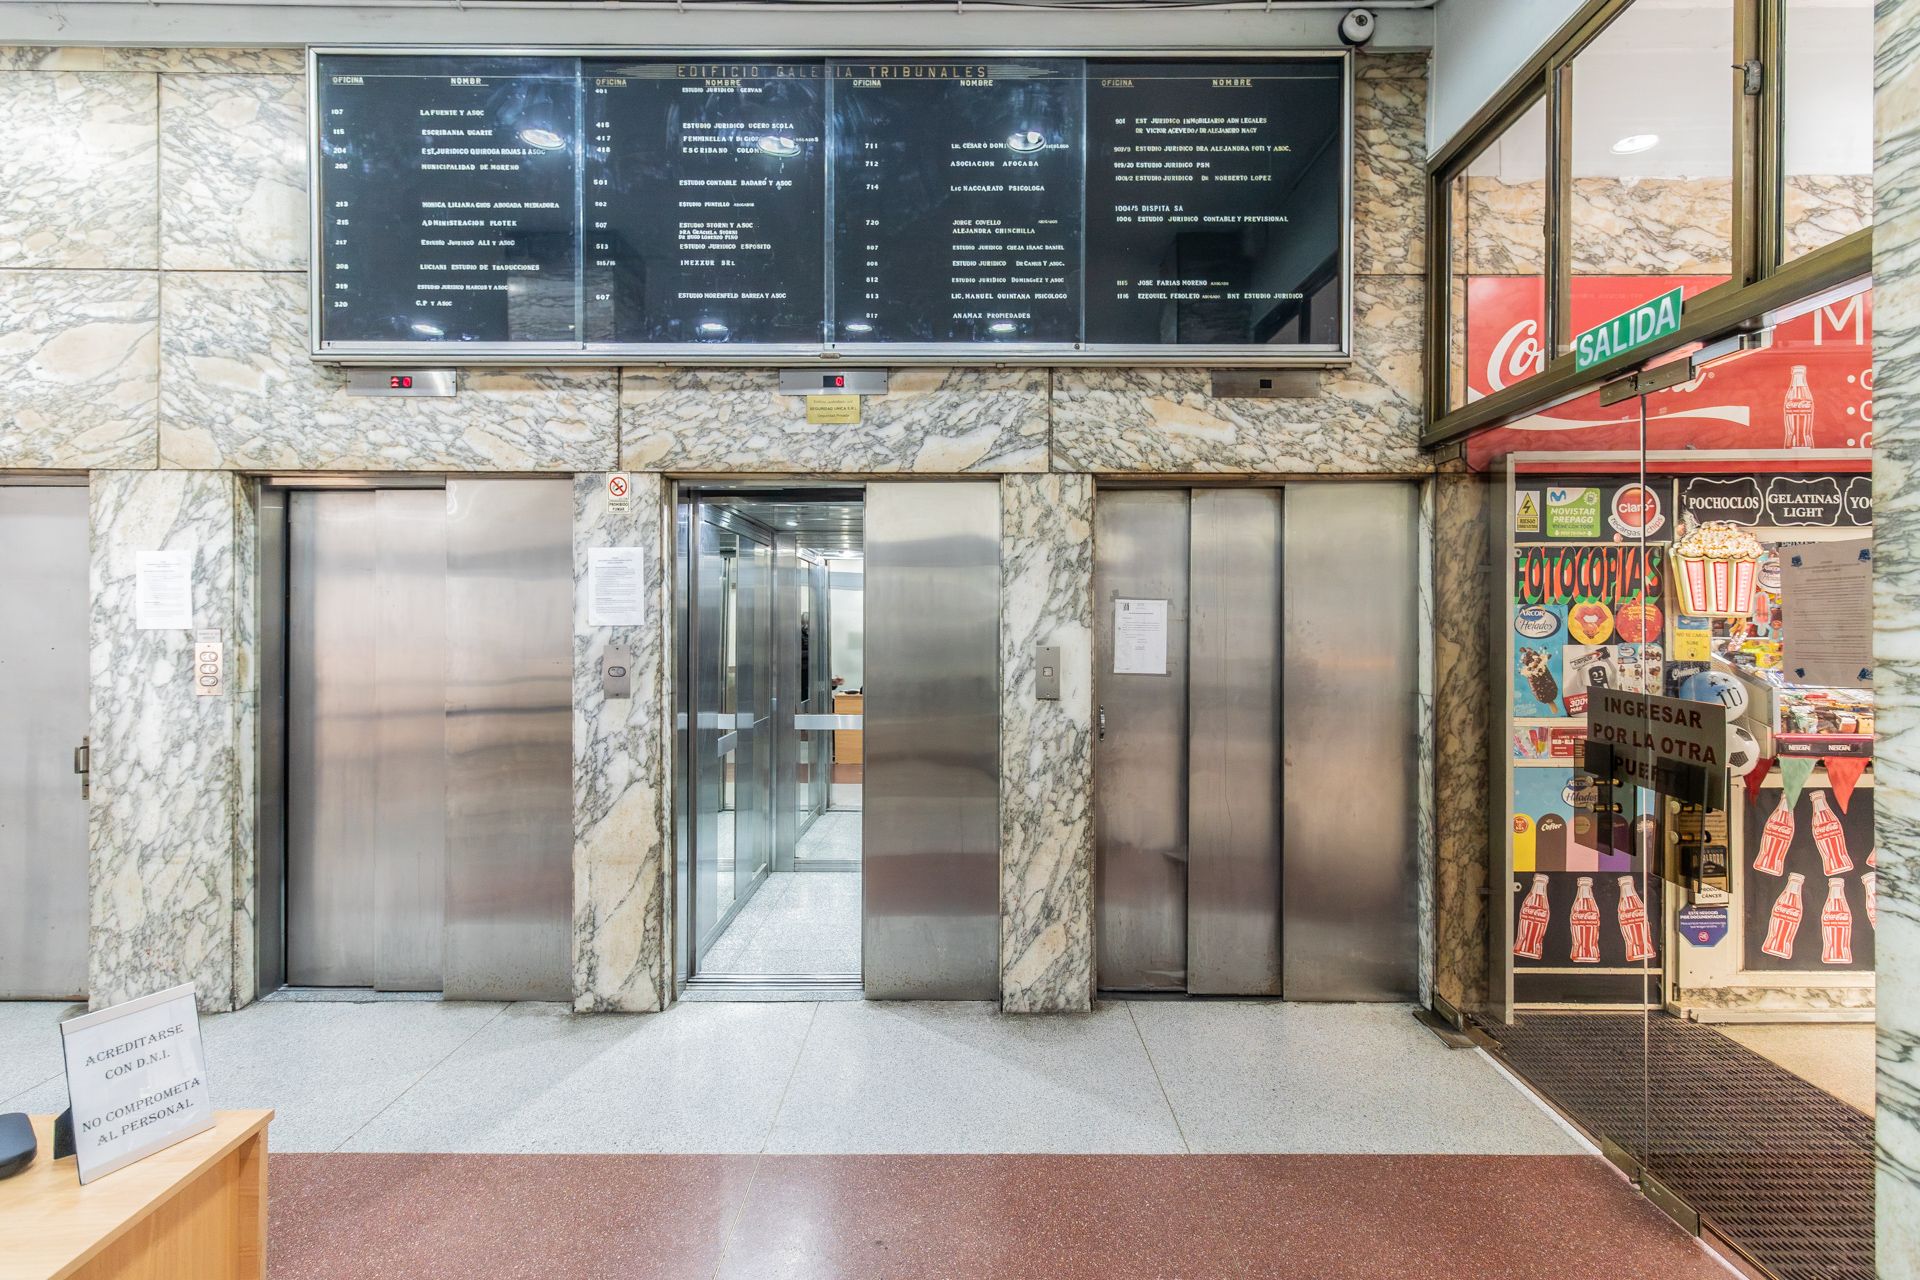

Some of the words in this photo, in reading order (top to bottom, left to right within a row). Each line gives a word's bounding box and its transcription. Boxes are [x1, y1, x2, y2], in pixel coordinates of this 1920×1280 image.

[677, 66, 759, 78] EDIFICIO
[776, 66, 853, 78] GALERIA
[869, 66, 986, 78] TRIBUNALES
[332, 76, 364, 84] OFICINA
[450, 77, 482, 85] NOMBR
[853, 79, 882, 87] OFICINA
[960, 79, 994, 87] NOMBRE
[1101, 79, 1133, 87] OFICINA
[1212, 79, 1252, 87] NOMBRE
[1135, 117, 1147, 125] EST
[1150, 117, 1181, 125] JURIDICO
[1183, 117, 1225, 125] INMOBILIARIO
[1240, 117, 1267, 125] LEGALES
[1135, 145, 1162, 153] ESTUDIO
[1163, 145, 1193, 153] JURIDICO
[1196, 145, 1209, 153] DRA
[1210, 145, 1250, 153] ALEJANDRA
[1266, 145, 1272, 153] Y
[1273, 145, 1291, 153] ASOC.
[679, 177, 706, 187] ESTUDIO
[706, 177, 737, 187] CONTABLE
[768, 177, 774, 187] Y
[775, 177, 792, 187] ASOC
[493, 201, 522, 209] ABOGADA
[1578, 296, 1676, 367] SALIDA
[1689, 496, 1760, 510] POCHOCLOS
[1768, 494, 1840, 504] GELATINAS
[1618, 502, 1649, 513] Claro
[1783, 507, 1824, 518] LIGHT
[1610, 518, 1641, 536] recargas
[1646, 517, 1662, 534] chips
[1515, 547, 1663, 602] FOTOCOPIAS
[1519, 608, 1545, 616] ARCOR
[1520, 620, 1553, 630] Helados
[1604, 696, 1702, 728] INGRESAR
[1594, 722, 1627, 744] POR
[1632, 730, 1655, 751] LA
[1661, 736, 1716, 765] OTRA
[1540, 822, 1562, 832] Cofler
[84, 1023, 184, 1067] ACREDITARSE
[104, 1063, 132, 1080] CON
[136, 1052, 171, 1070] D.N.I.
[82, 1116, 101, 1134] NO
[105, 1078, 201, 1123] COMPROMETA
[96, 1130, 119, 1148] AL
[121, 1098, 194, 1138] PERSONAL
